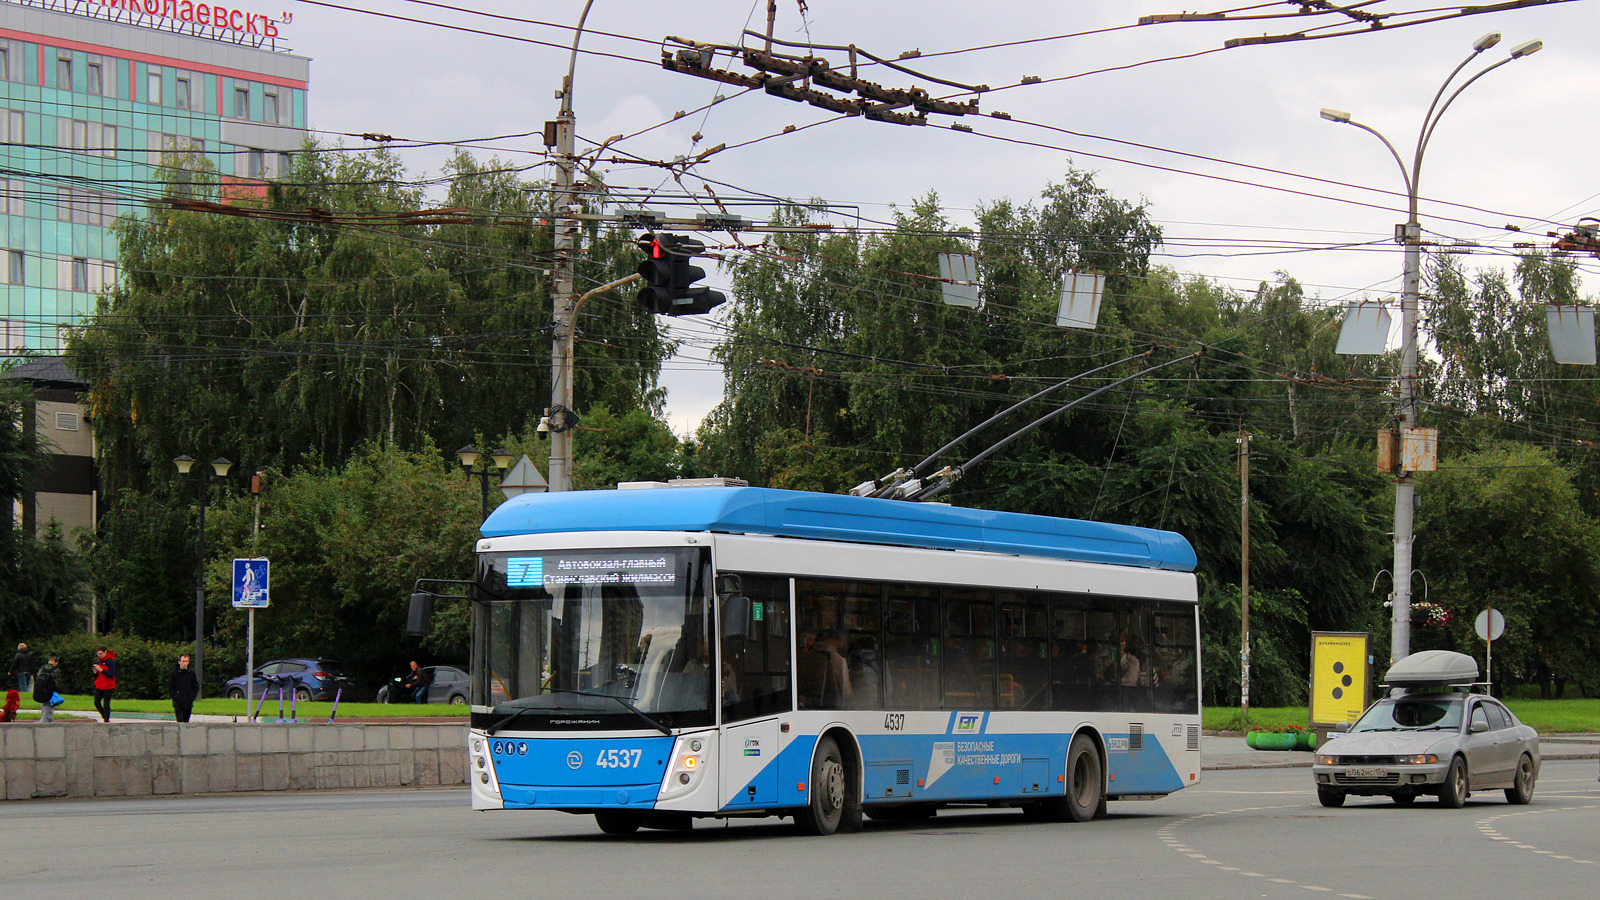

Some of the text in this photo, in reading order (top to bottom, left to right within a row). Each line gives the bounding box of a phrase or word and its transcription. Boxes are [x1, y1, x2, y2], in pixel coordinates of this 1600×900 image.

[557, 557, 666, 570] Автовокзал-главный
[518, 563, 530, 583] 7
[543, 573, 619, 584] Станиславский
[884, 713, 905, 731] 4537
[957, 741, 994, 752] БЕЗОПАСНЫЕ
[596, 749, 642, 768] 4537
[957, 754, 999, 766] КАЧЕСТВЕННЫЕ
[1000, 753, 1021, 767] ДОРОГИ
